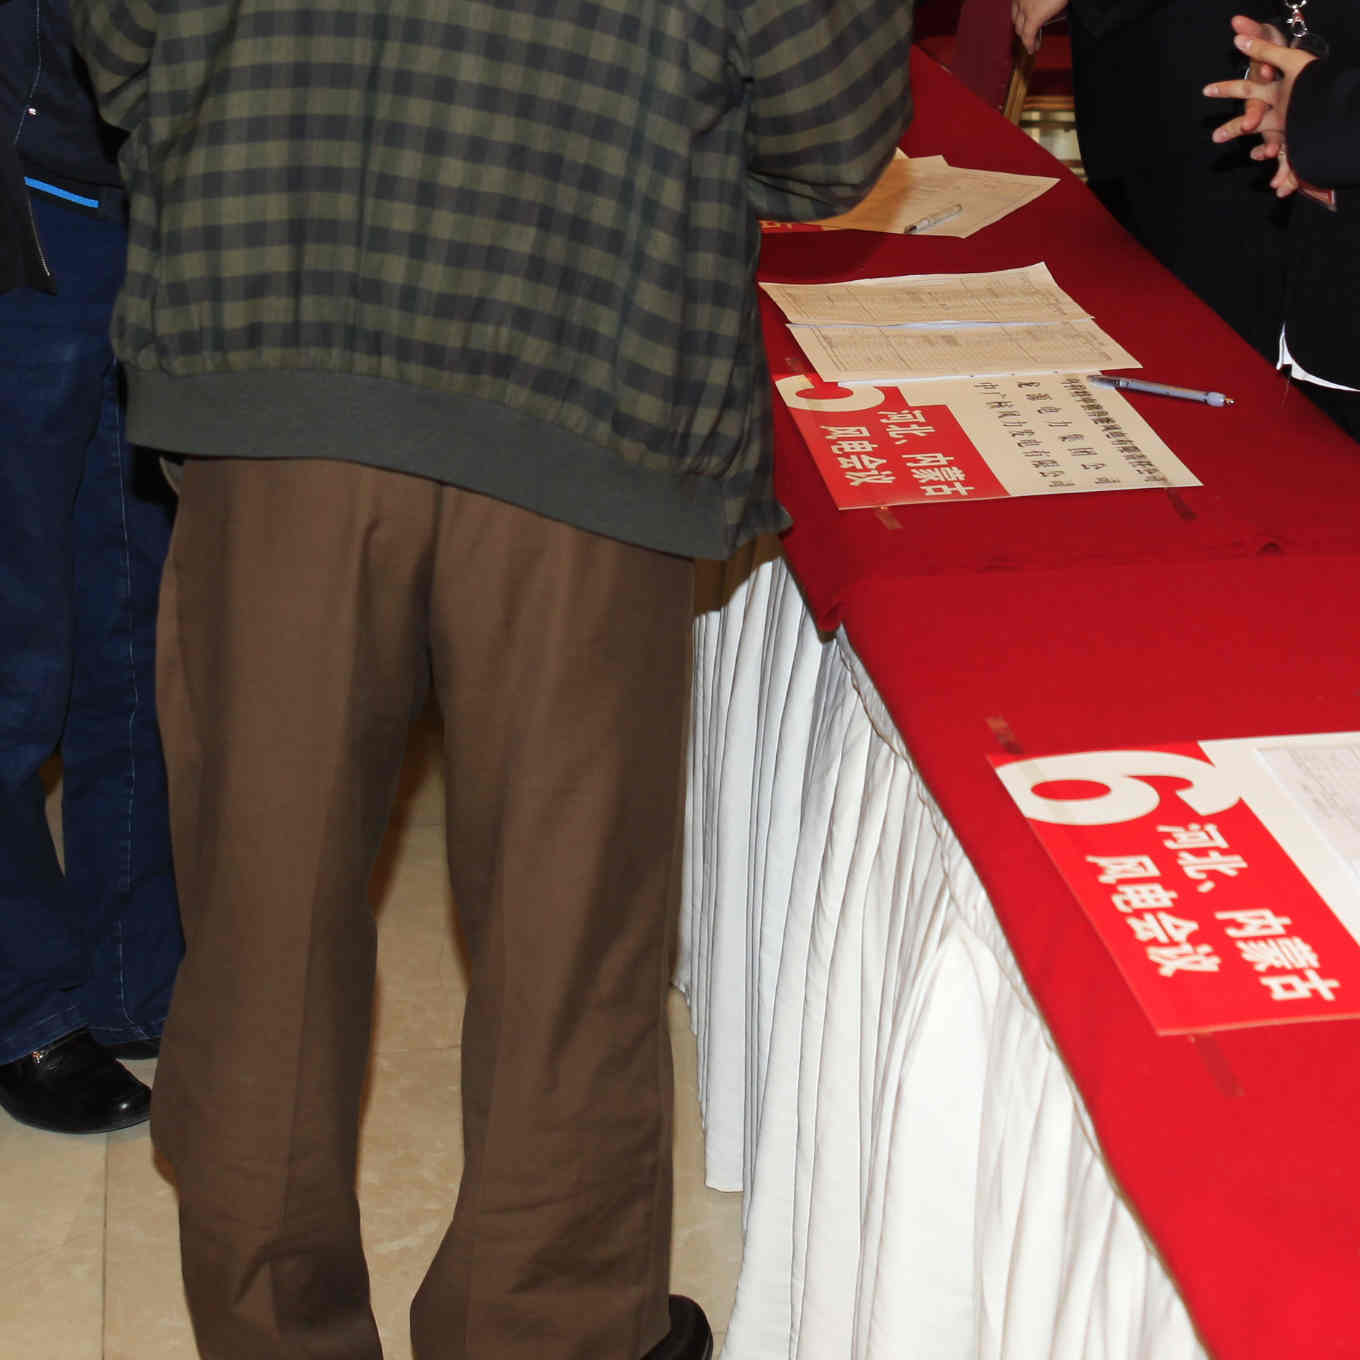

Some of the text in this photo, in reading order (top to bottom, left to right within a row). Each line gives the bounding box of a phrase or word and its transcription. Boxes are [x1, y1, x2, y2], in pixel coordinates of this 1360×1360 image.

[820, 425, 897, 486] 风电会议
[876, 409, 976, 496] 河北、内蒙古
[995, 749, 1241, 826] 6
[1085, 854, 1222, 977] 风电会议
[1156, 822, 1341, 1001] 河北、内蒙古
